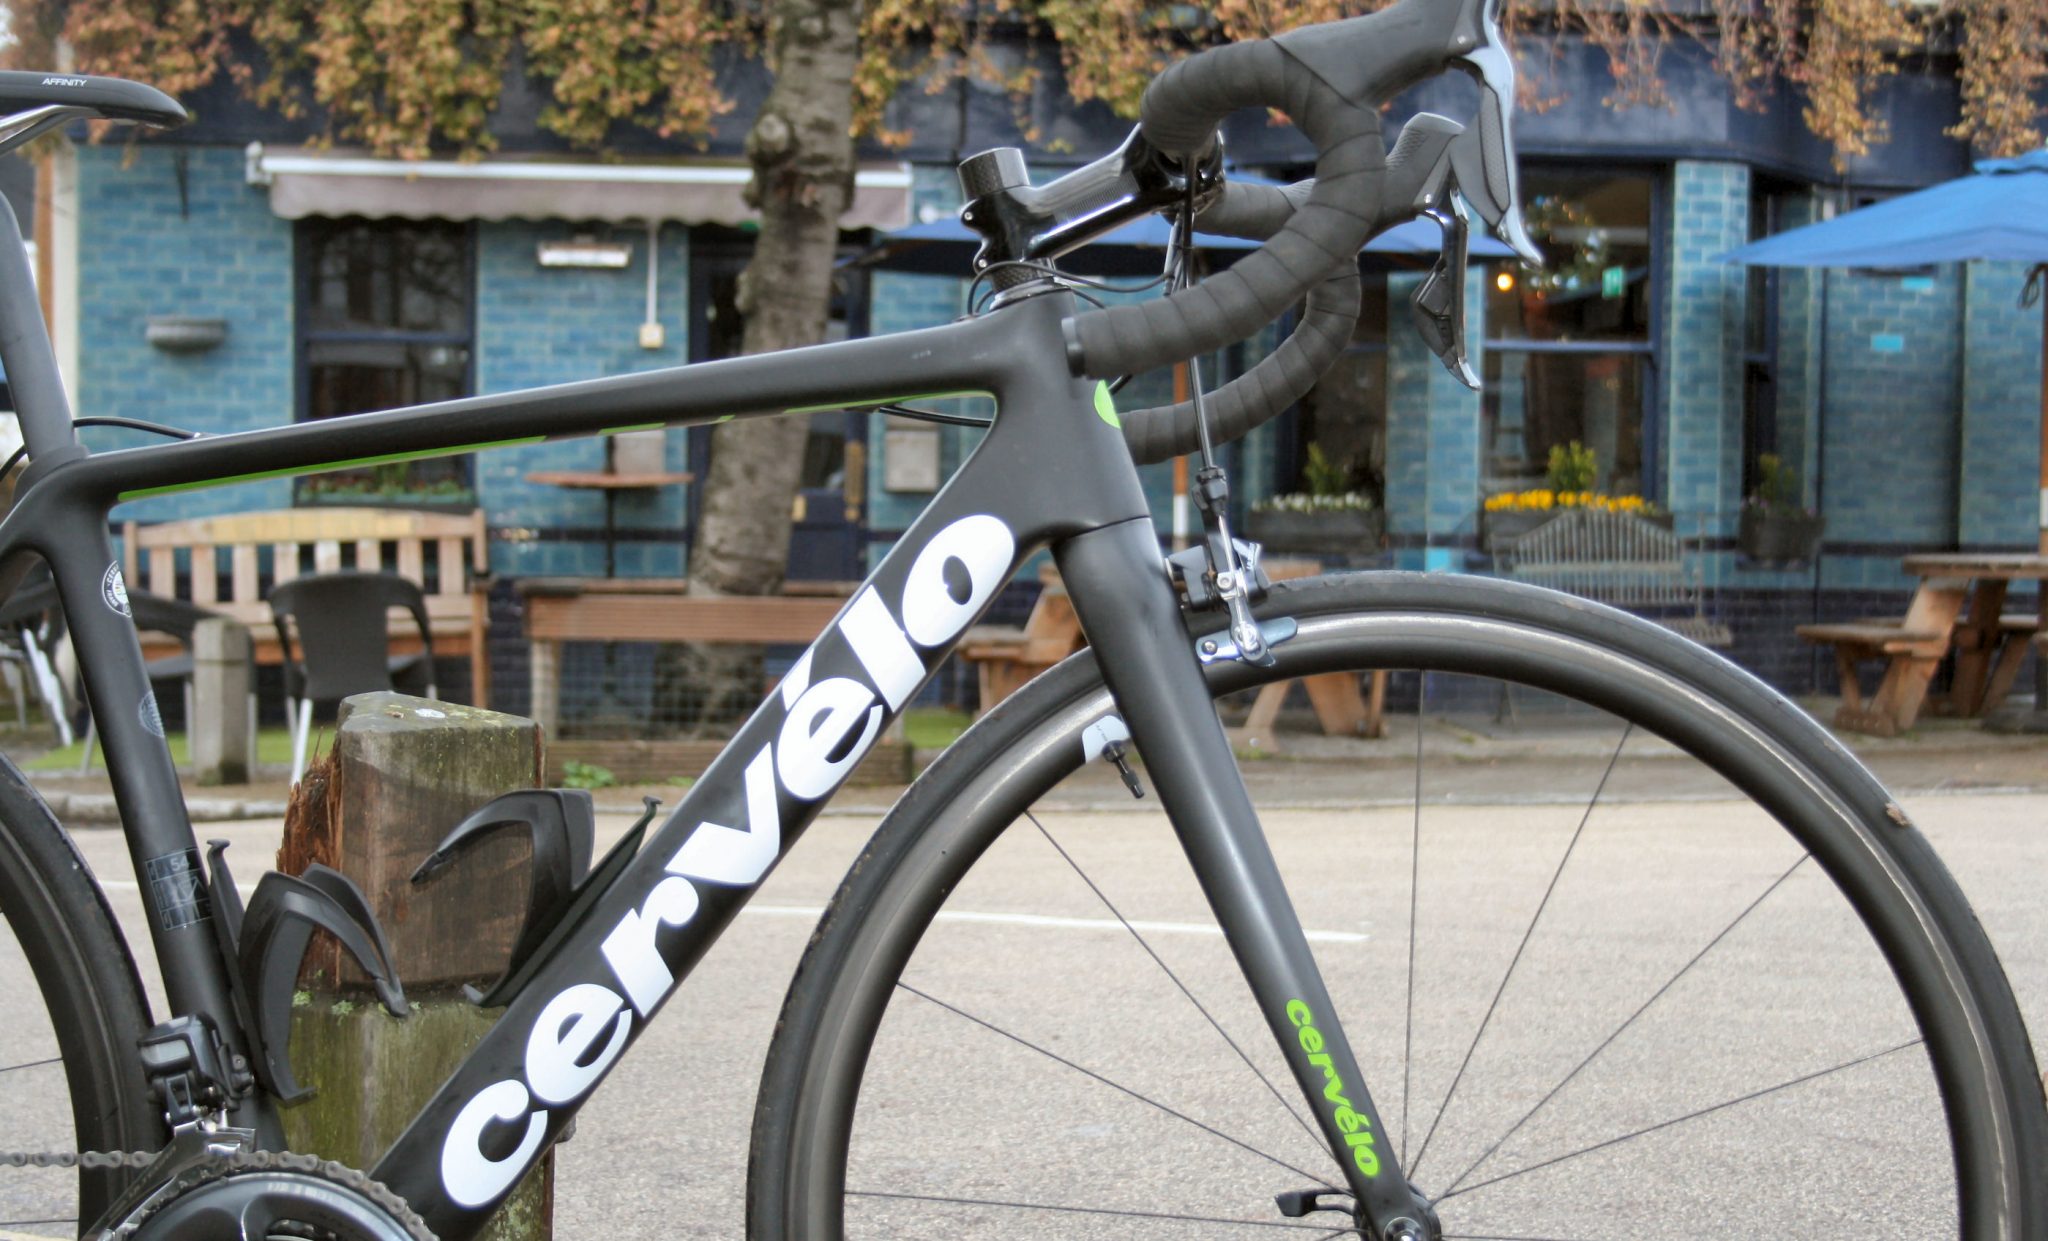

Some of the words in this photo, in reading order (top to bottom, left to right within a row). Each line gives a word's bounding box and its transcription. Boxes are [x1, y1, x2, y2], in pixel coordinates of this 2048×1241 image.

[42, 78, 87, 87] AFFINITY
[441, 514, 1015, 1206] cervélo
[1286, 999, 1379, 1177] cervélo
